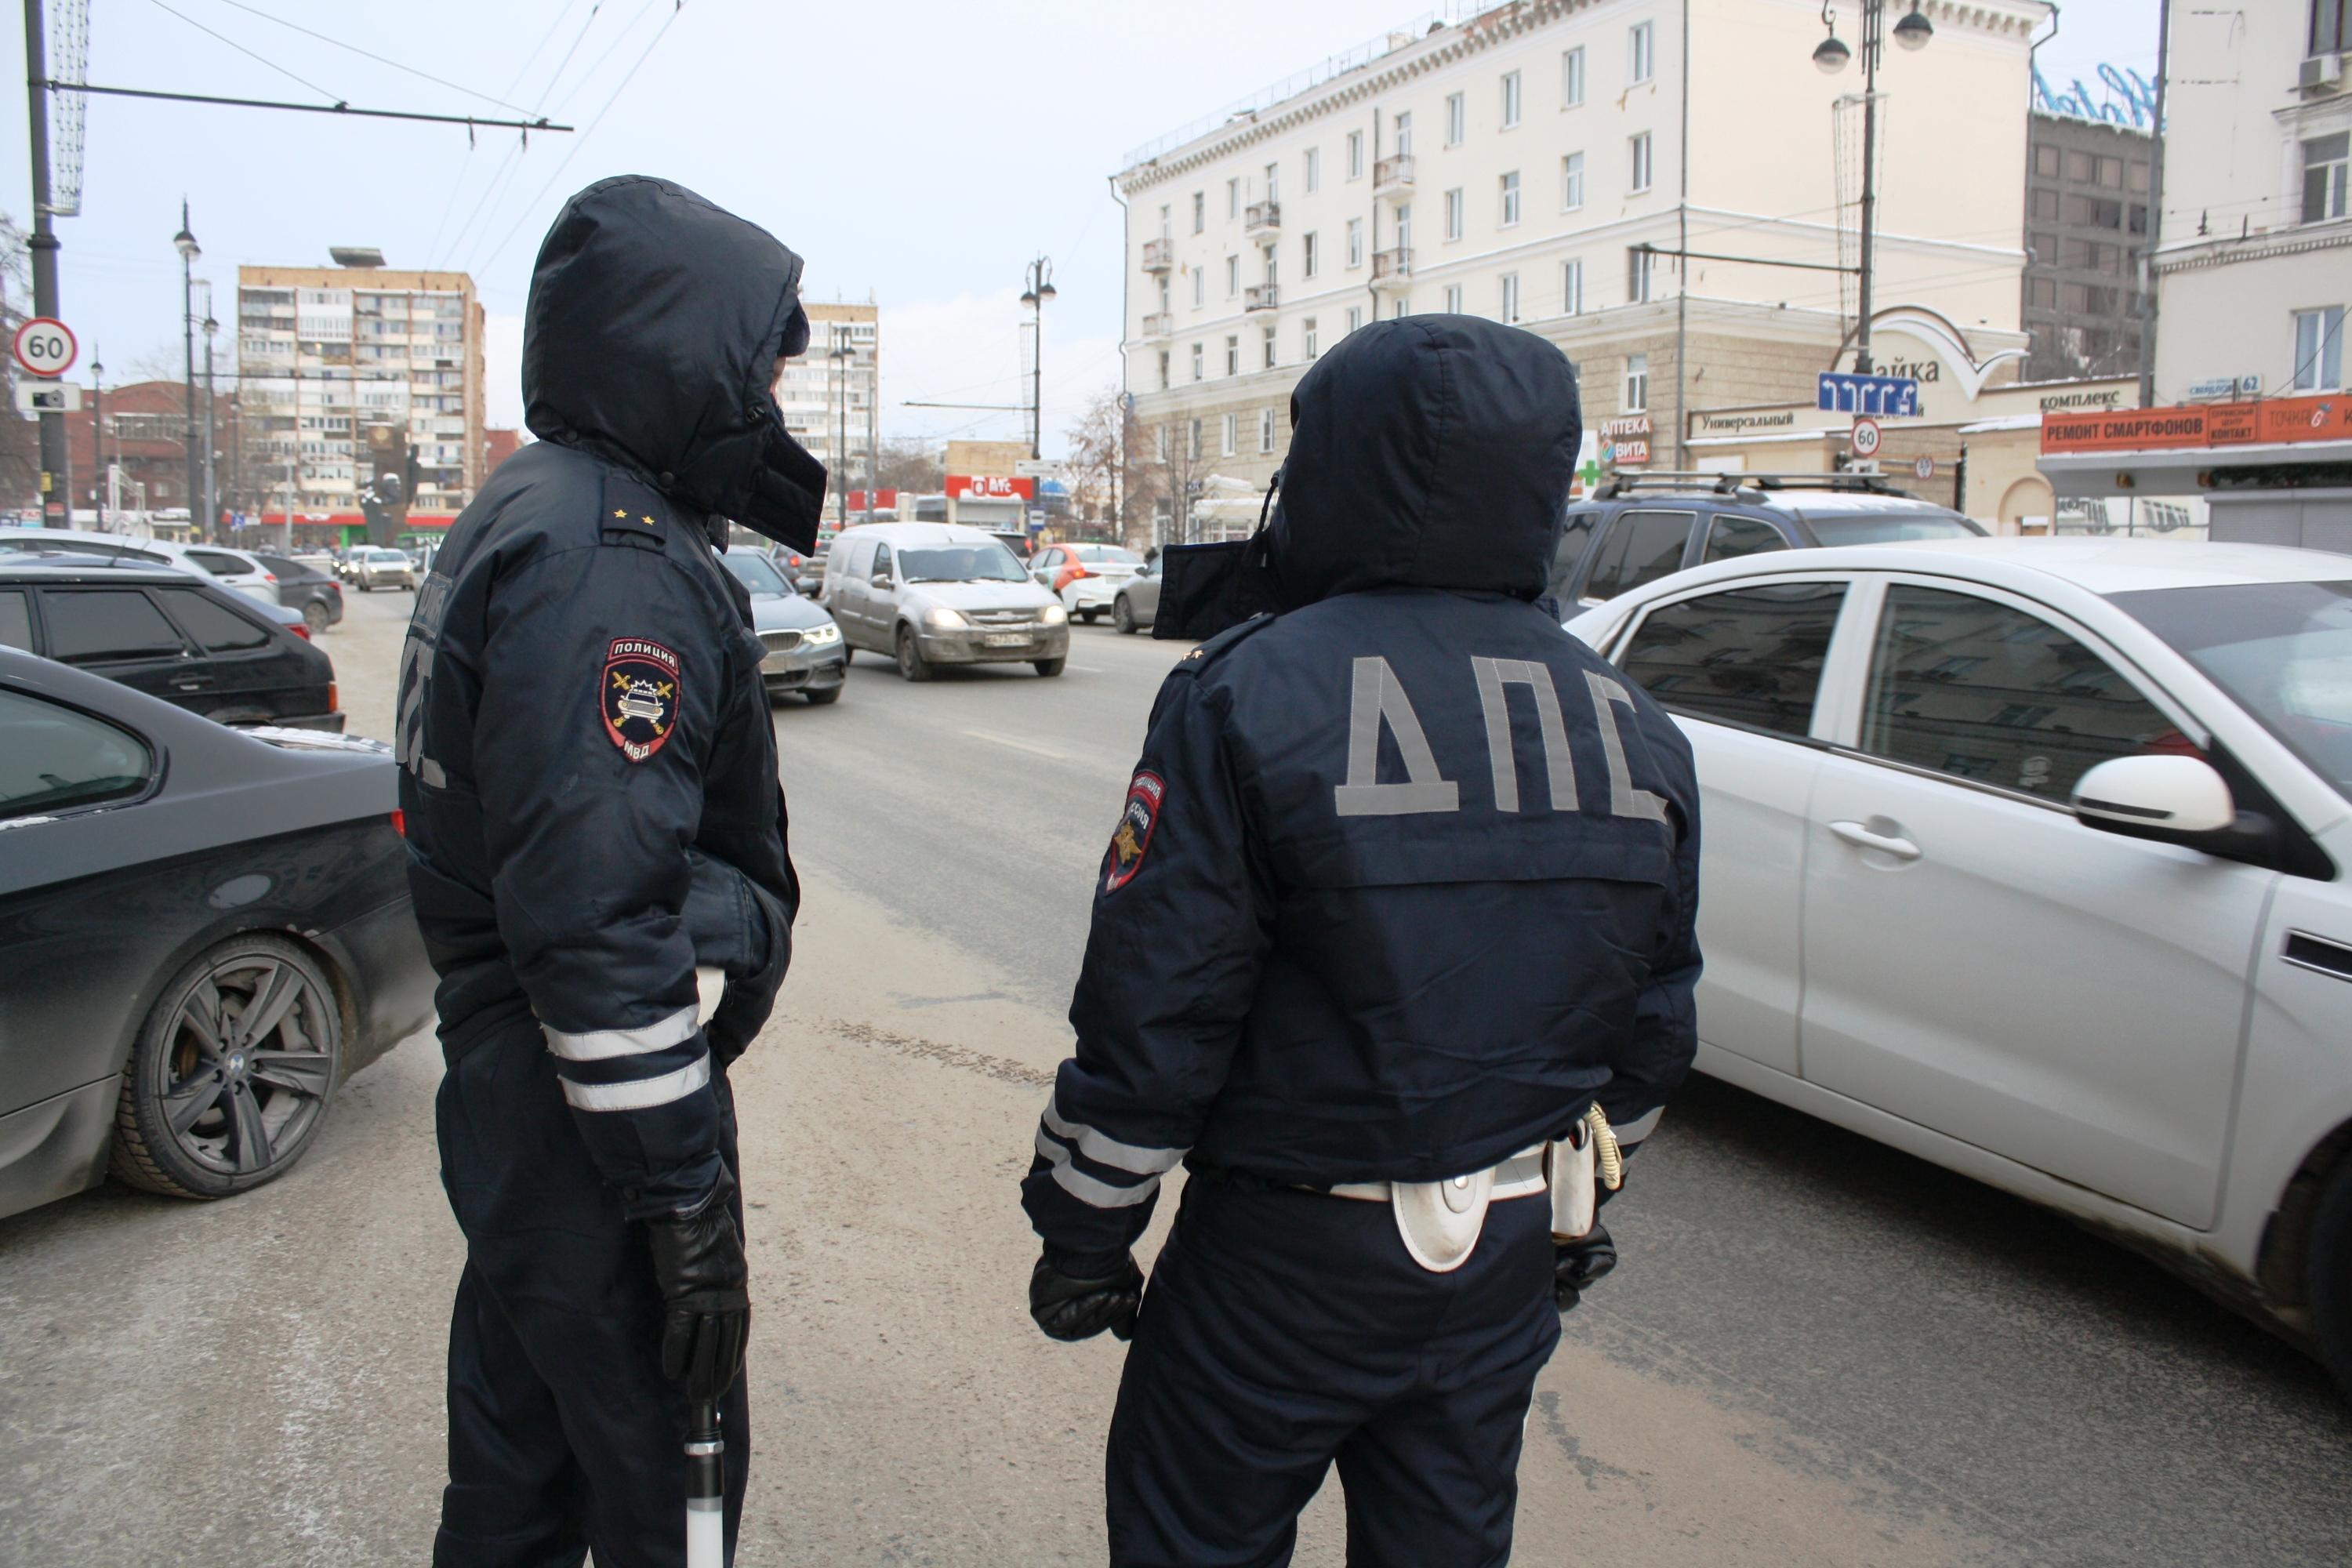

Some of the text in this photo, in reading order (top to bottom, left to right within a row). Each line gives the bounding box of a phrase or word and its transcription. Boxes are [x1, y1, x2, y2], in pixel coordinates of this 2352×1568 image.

[29, 335, 64, 359] 60
[1855, 356, 1940, 383] айка
[2242, 376, 2259, 390] 62
[1601, 417, 1650, 436] АПТЕКА
[1702, 412, 1795, 433] Универсальный
[2047, 418, 2203, 441] РЕМОНТ СМАРТФОНОВ
[1858, 430, 1875, 445] 60
[2211, 427, 2252, 439] КОНТАКТ
[1615, 440, 1647, 457] ВИТА
[614, 641, 675, 668] ПОЛИЦИЯ
[624, 741, 650, 760] МВД
[1334, 655, 1670, 826] ДПС
